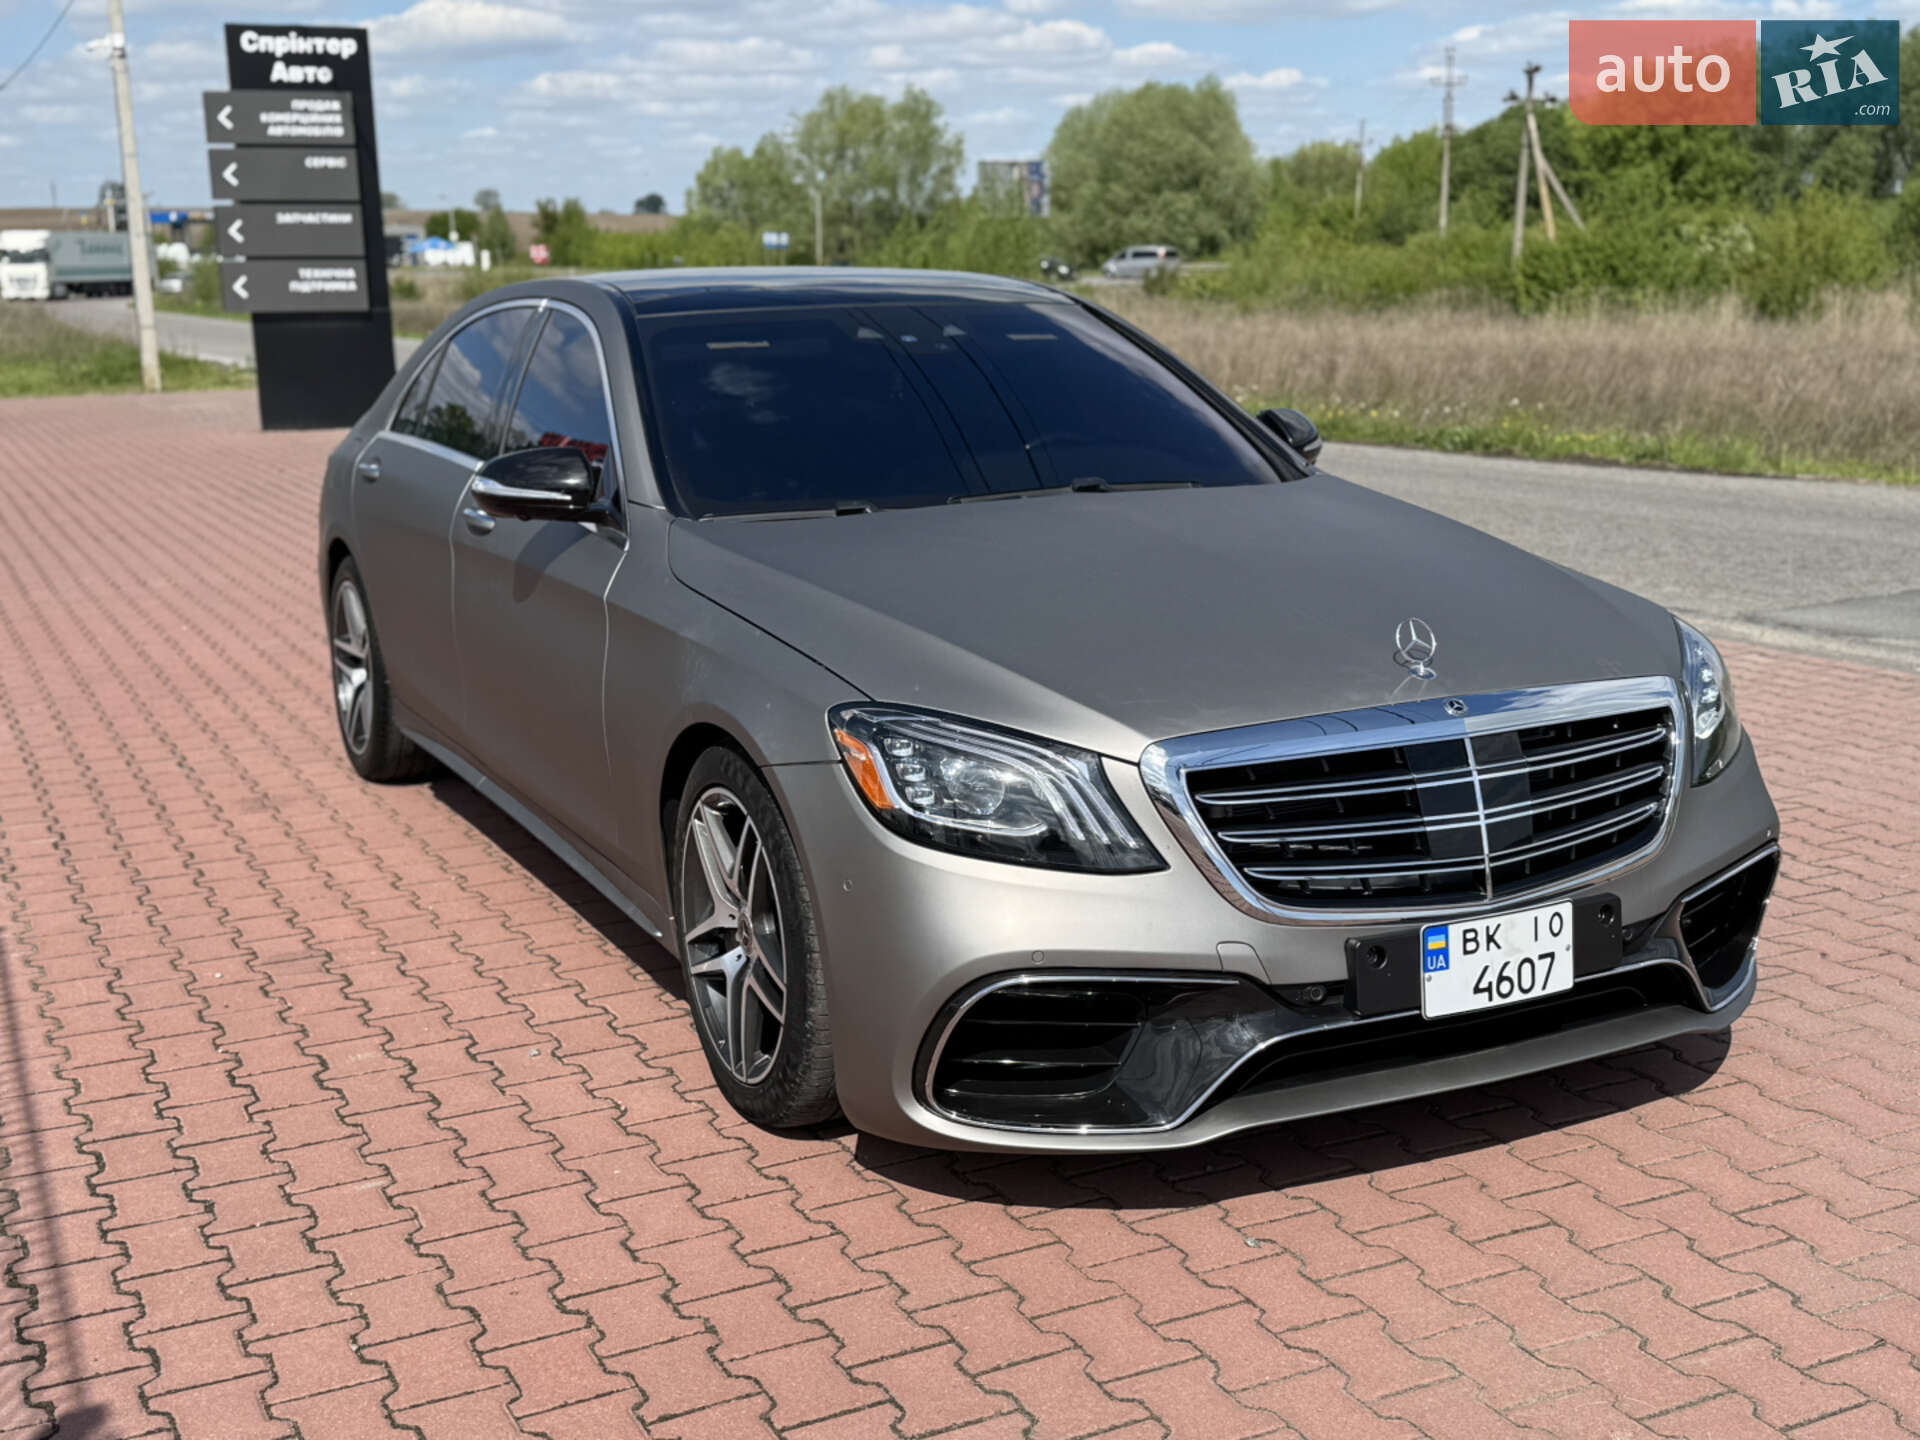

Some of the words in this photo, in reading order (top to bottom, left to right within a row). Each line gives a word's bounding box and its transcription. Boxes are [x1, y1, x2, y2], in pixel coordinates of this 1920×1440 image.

[239, 30, 358, 59] Спрінтер
[270, 60, 333, 84] Авто
[1462, 923, 1502, 955] BK
[1427, 953, 1447, 971] UA
[1472, 951, 1556, 1003] 4607
